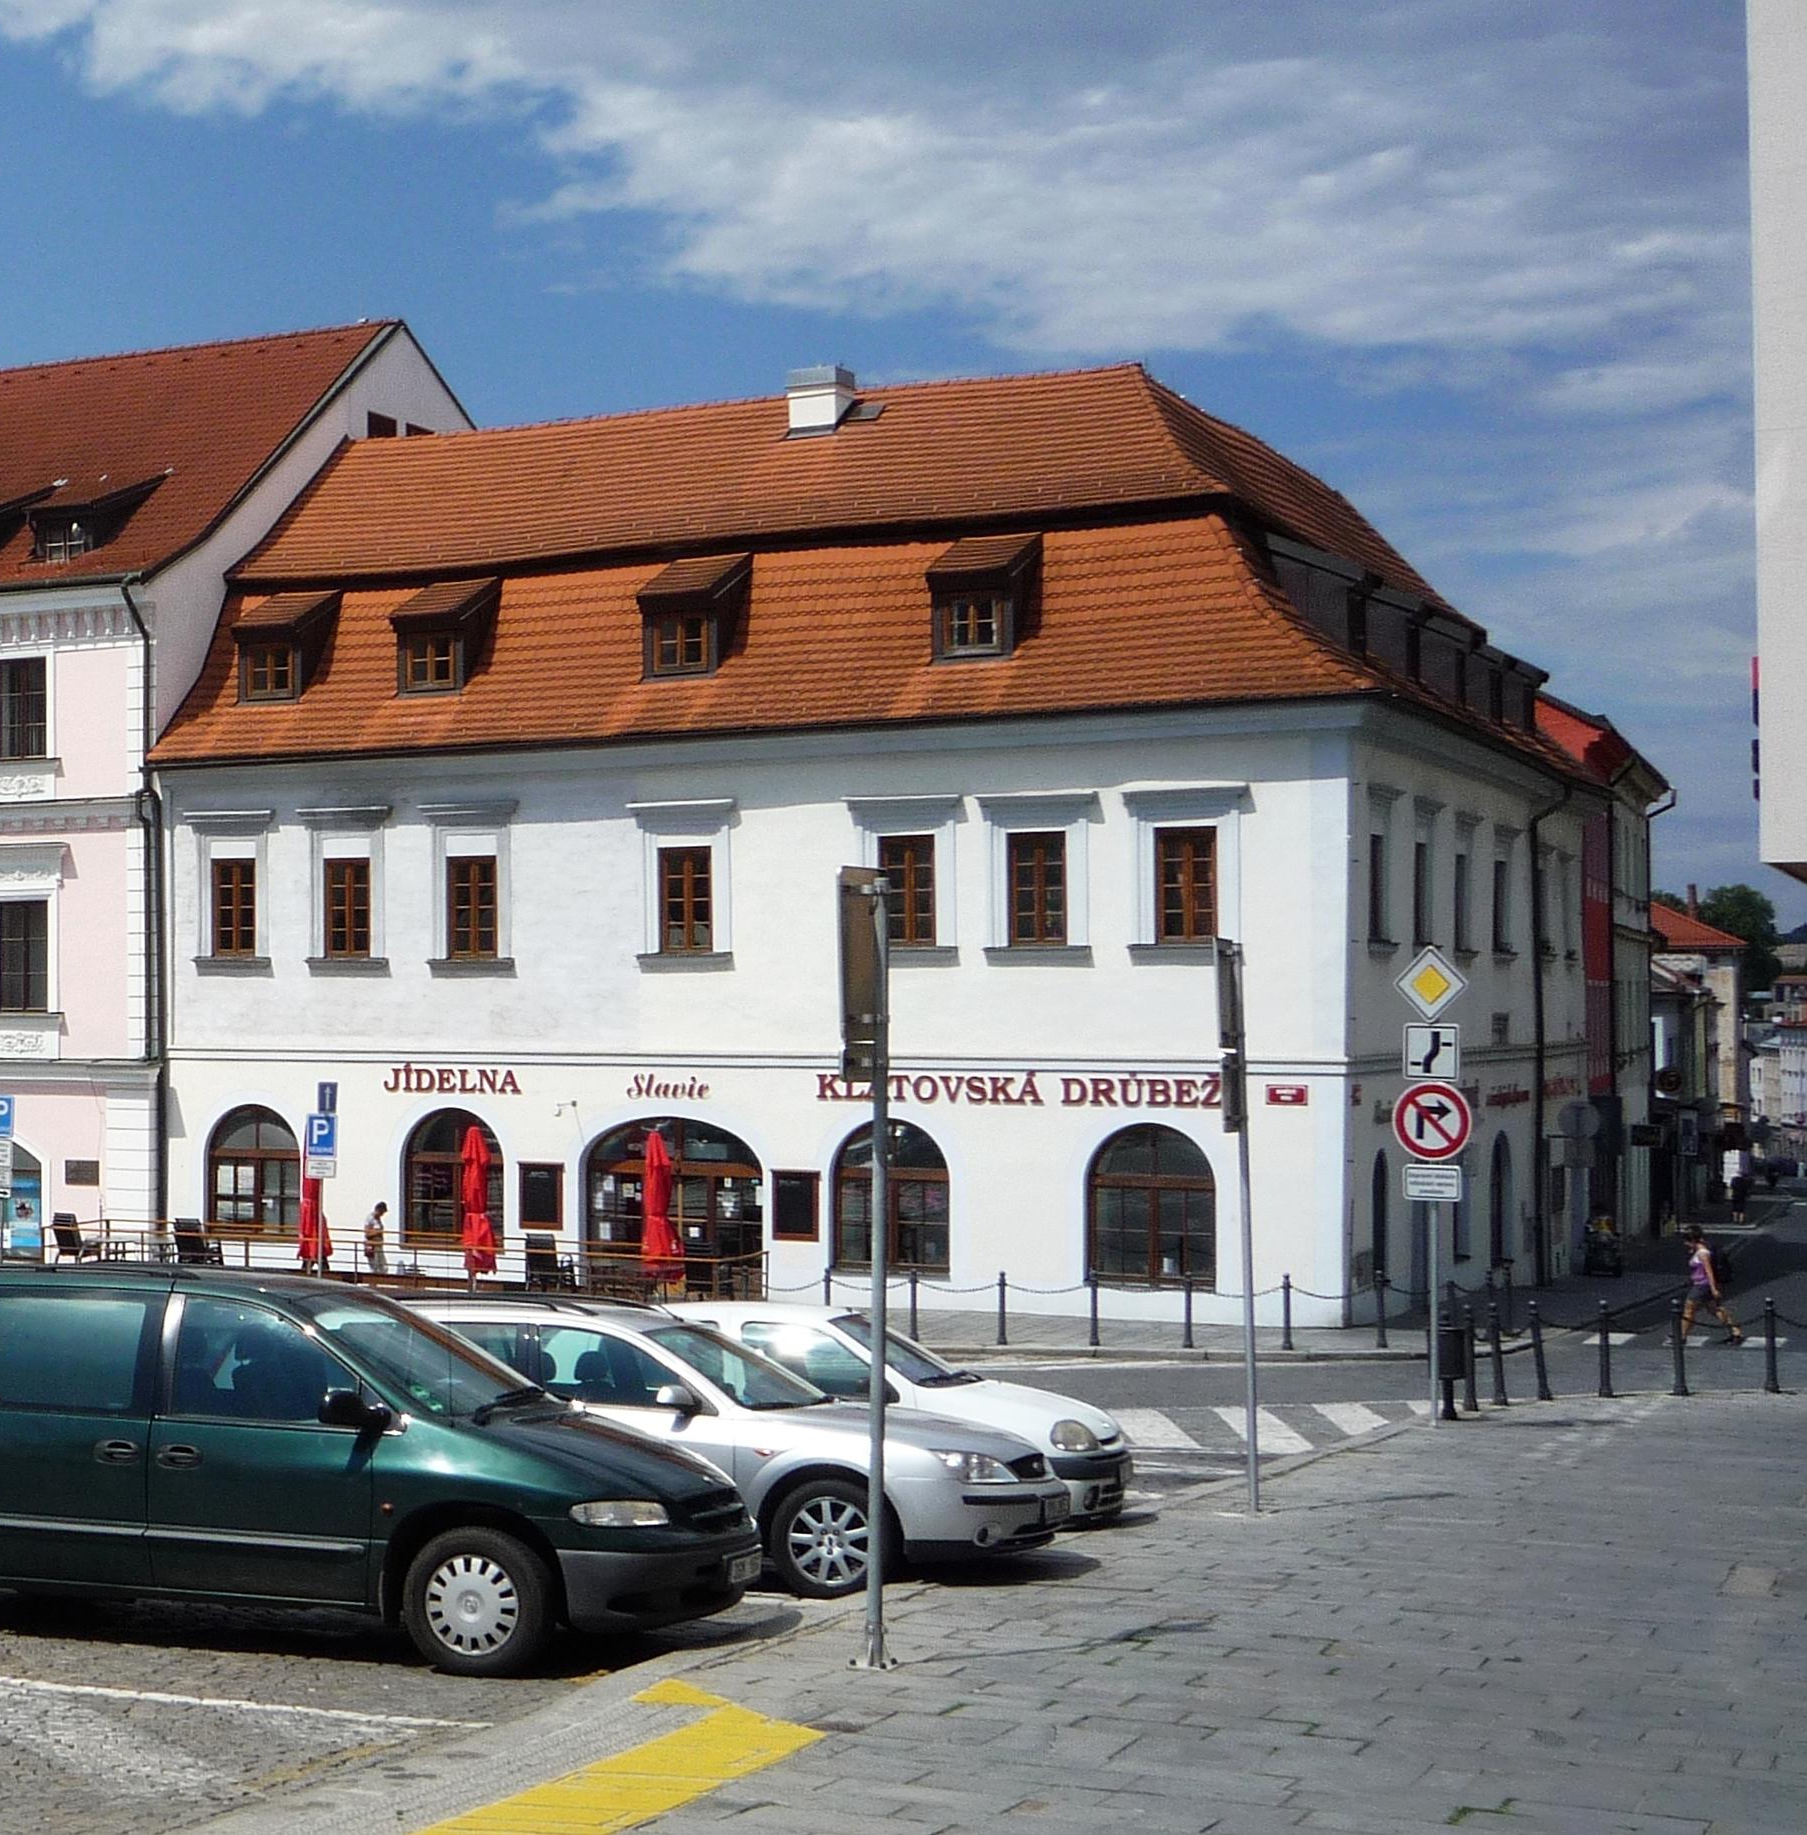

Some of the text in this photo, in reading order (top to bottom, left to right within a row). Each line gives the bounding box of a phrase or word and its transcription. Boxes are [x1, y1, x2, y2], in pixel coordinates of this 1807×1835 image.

[384, 1061, 522, 1094] JÍDELNA
[627, 1073, 712, 1100] Slavie
[1060, 1071, 1222, 1108] DRŮBEŽ
[312, 1119, 330, 1145] P
